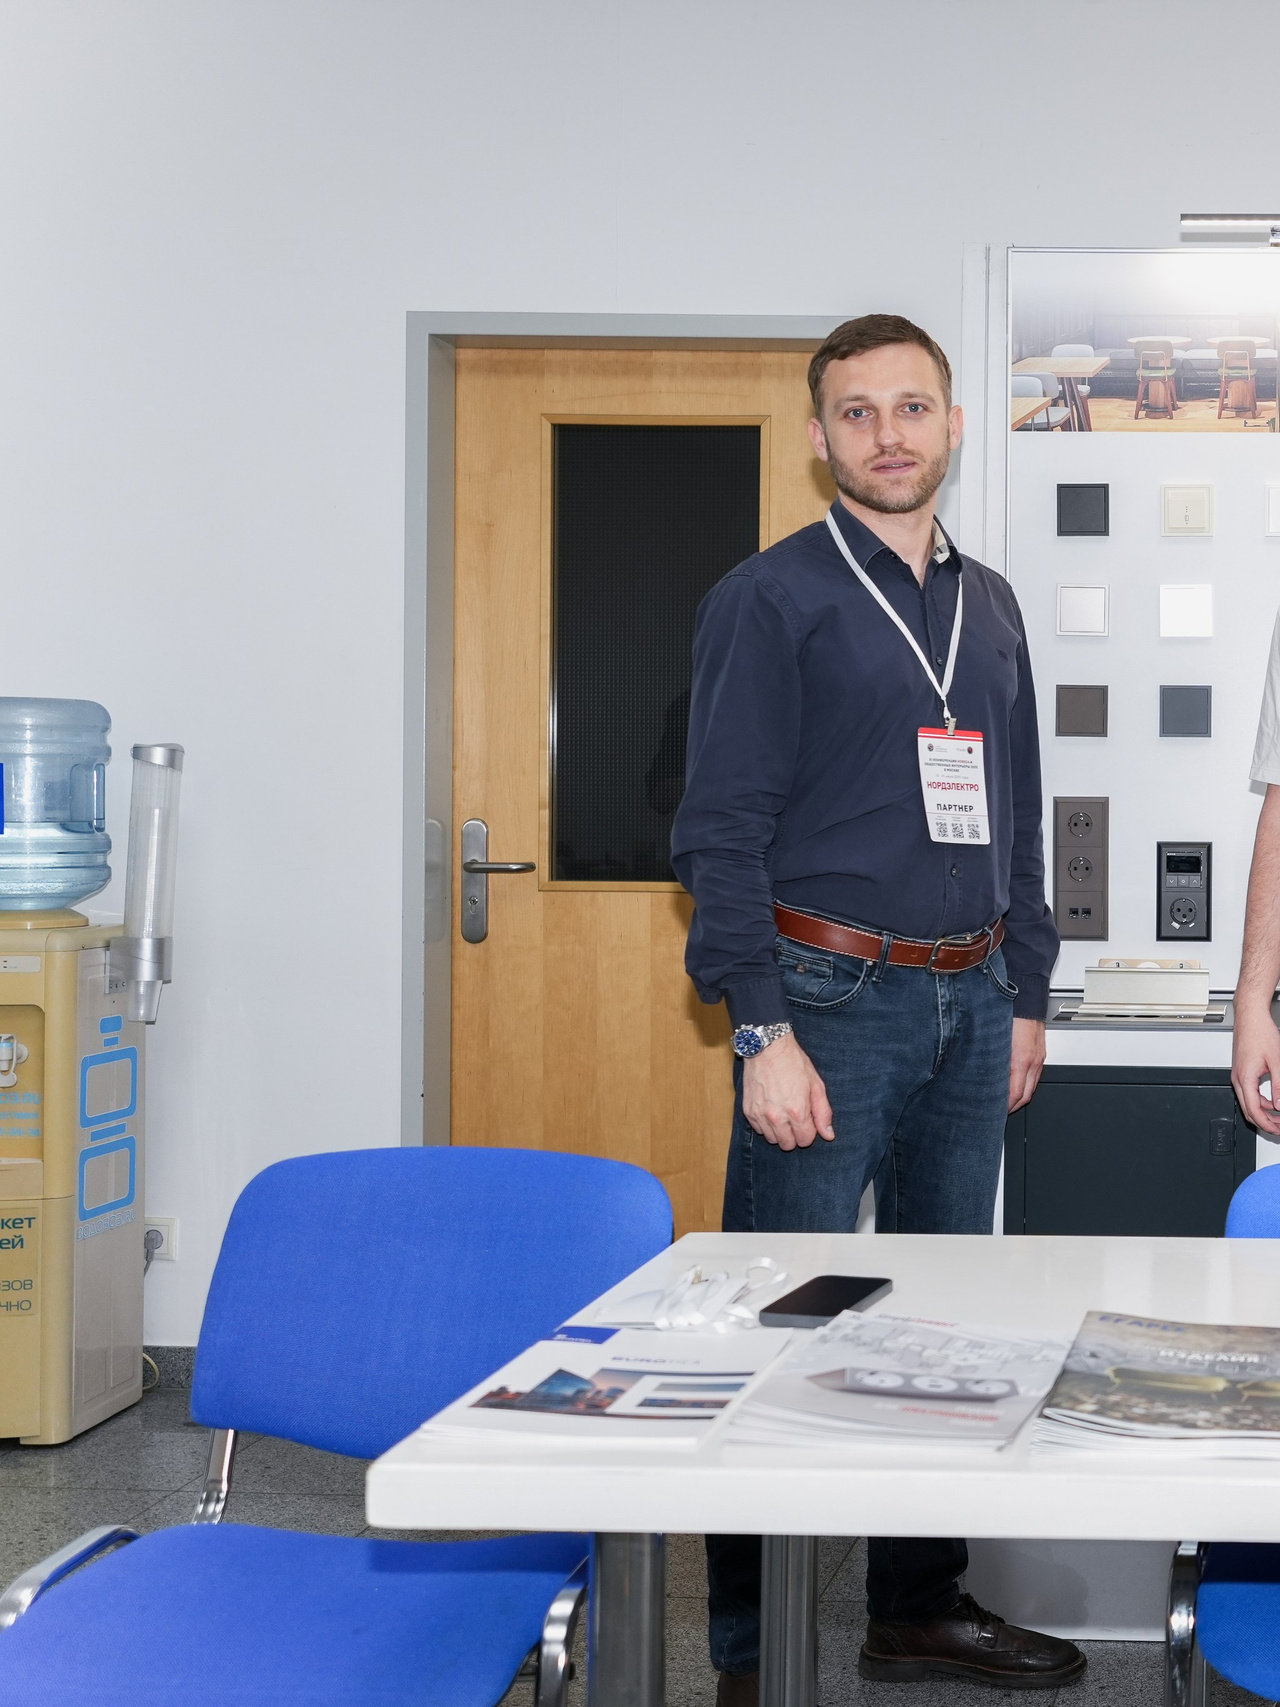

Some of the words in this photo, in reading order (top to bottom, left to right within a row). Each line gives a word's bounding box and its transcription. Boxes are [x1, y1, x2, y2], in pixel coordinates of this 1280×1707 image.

[927, 781, 979, 791] НОРДЭЛЕКТРО
[936, 803, 974, 812] ПАРТНЕР
[0, 1279, 33, 1291] ЗОВ
